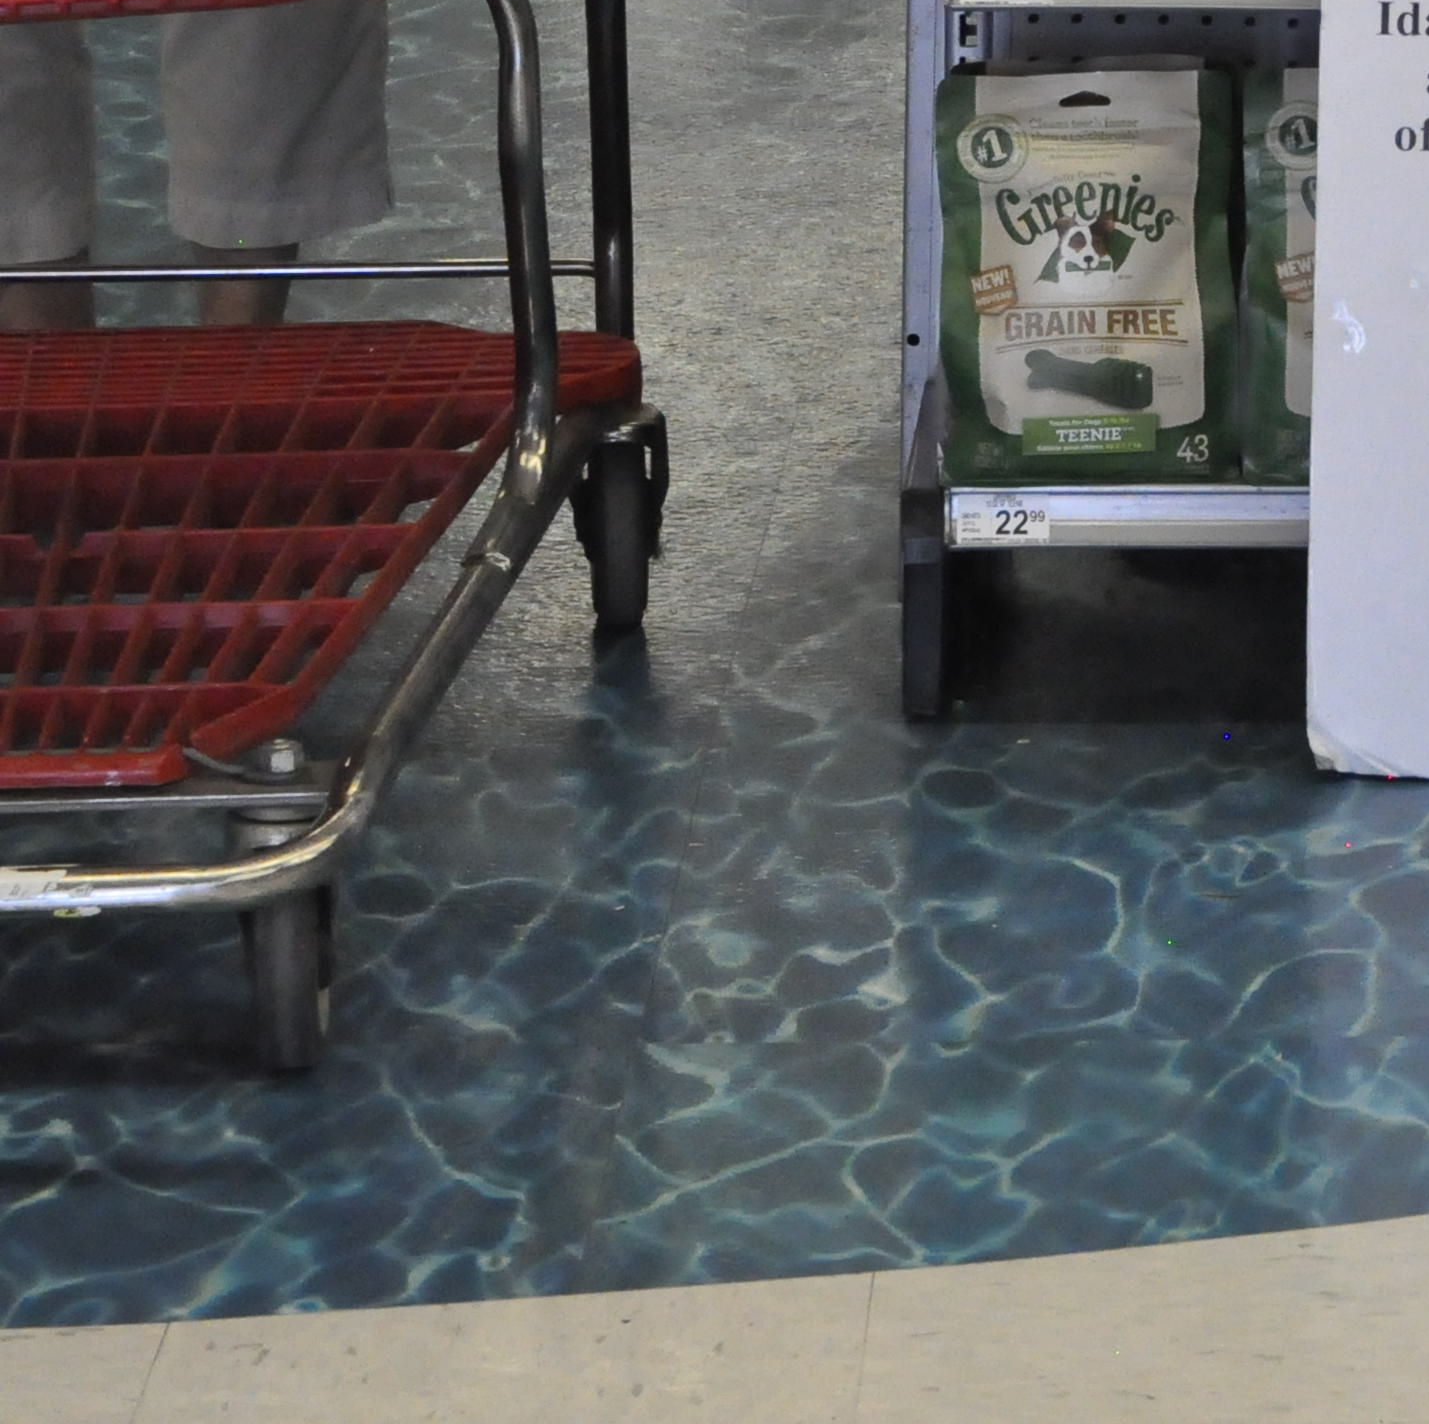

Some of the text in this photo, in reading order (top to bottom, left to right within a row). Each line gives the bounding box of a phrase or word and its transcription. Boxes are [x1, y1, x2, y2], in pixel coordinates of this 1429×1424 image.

[995, 174, 1176, 246] Greenies
[971, 266, 1011, 293] NEW!
[1004, 308, 1179, 342] GRAIN FREE
[1056, 426, 1122, 442] TEENIE
[1176, 434, 1209, 463] 43
[994, 509, 1028, 535] 22
[1029, 511, 1046, 522] 99
